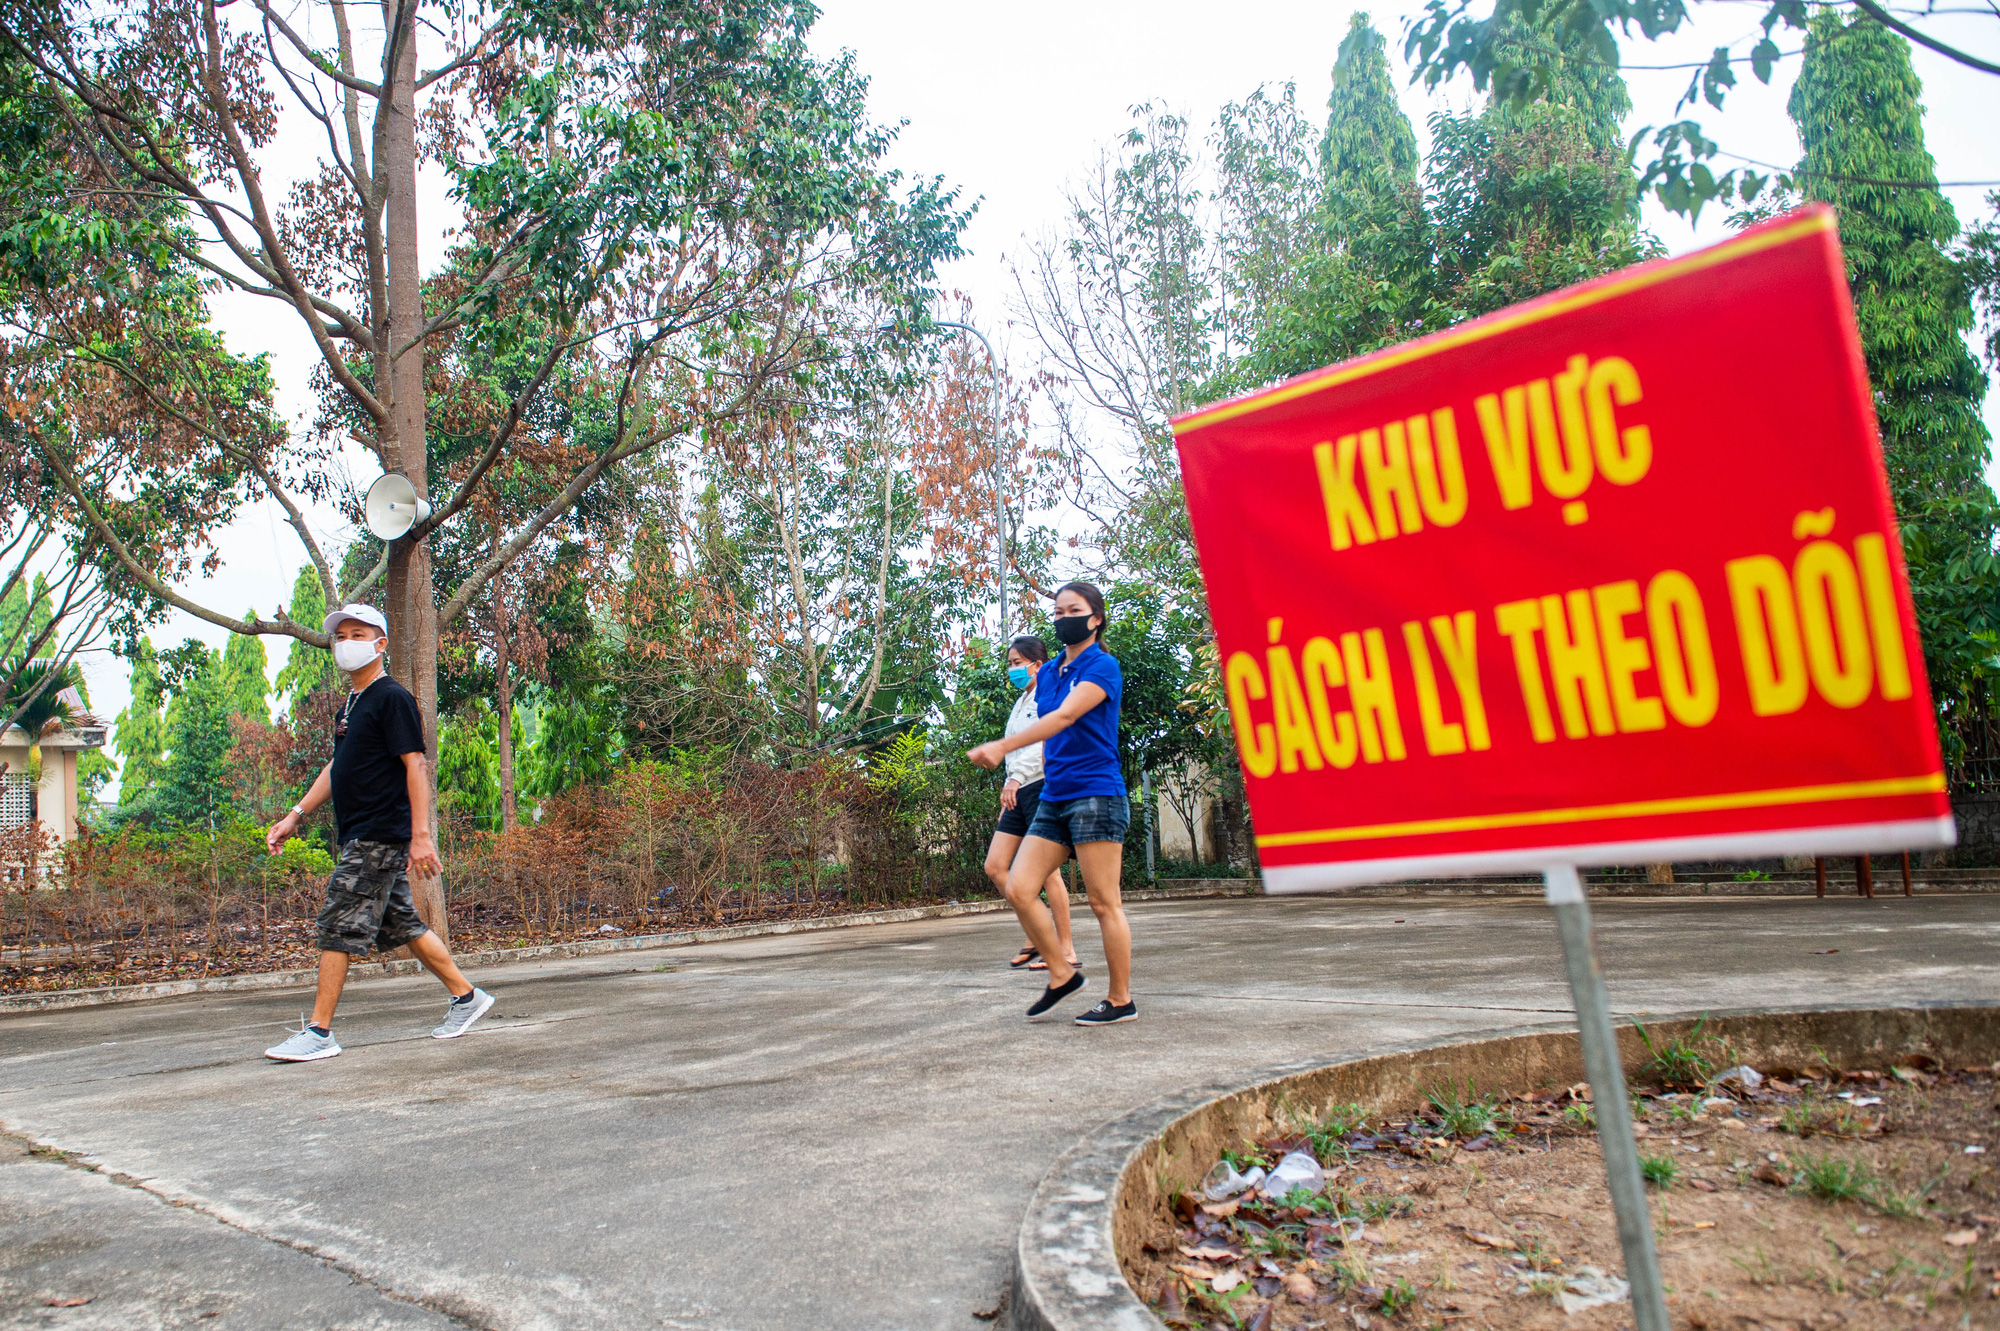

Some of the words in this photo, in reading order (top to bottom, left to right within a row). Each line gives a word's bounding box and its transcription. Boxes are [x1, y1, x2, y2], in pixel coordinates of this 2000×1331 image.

[1313, 406, 1468, 551] KHU
[1475, 353, 1652, 525] VỰC
[1226, 617, 1406, 778] CÁCH
[1402, 610, 1491, 756] LY
[1495, 569, 1720, 743] THEO
[1725, 507, 1911, 717] DÕI
